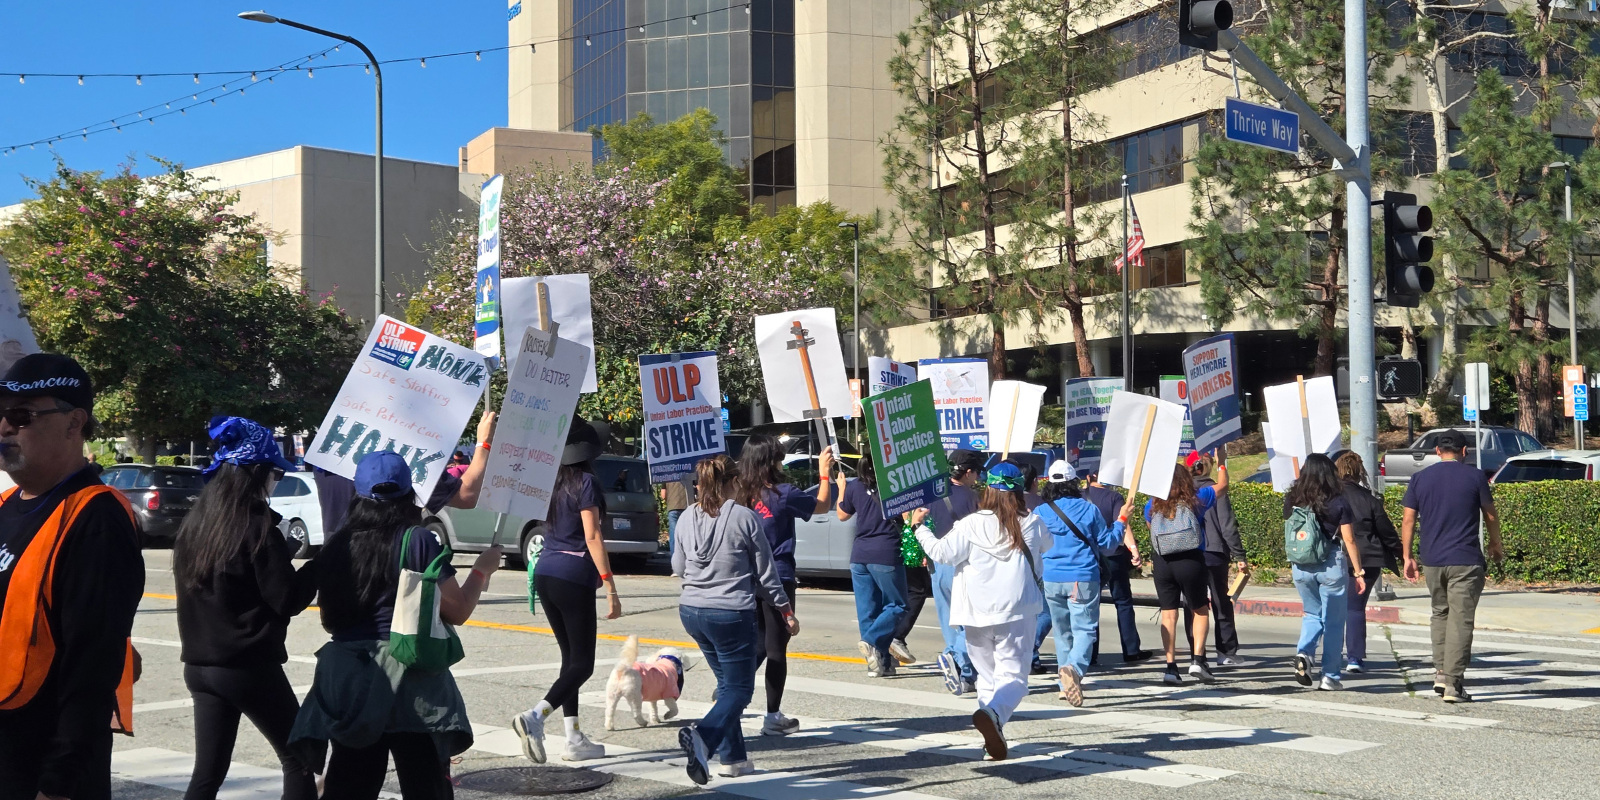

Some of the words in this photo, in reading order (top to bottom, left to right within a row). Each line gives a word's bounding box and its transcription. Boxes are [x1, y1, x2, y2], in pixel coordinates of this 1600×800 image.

[1232, 109, 1267, 137] Thrive
[1271, 118, 1293, 147] Way
[383, 322, 406, 339] ULP
[378, 334, 417, 354] STRIKE
[524, 359, 539, 379] DO
[1189, 356, 1227, 381] HEALTHCARE
[1192, 347, 1218, 367] SUPPORT
[0, 376, 81, 392] Cancun
[359, 360, 396, 385] Safe
[401, 377, 450, 407] Staffing
[652, 363, 702, 406] ULP
[880, 370, 908, 387] STRIKE
[1190, 371, 1232, 405] WORKERS
[650, 411, 665, 422] Unfair
[667, 409, 684, 419] Labor
[686, 404, 713, 416] Practice
[875, 392, 913, 422] Unfair
[942, 397, 958, 405] Labor
[959, 396, 983, 405] Practice
[1076, 406, 1088, 418] RISE
[340, 395, 371, 414] Safe
[375, 406, 418, 431] Patient
[417, 426, 443, 441] Care
[880, 414, 917, 443] Labor
[935, 407, 985, 431] TRIKE
[317, 414, 446, 486] HOK
[499, 442, 528, 458] RESPECT
[648, 417, 720, 459] STRIKE
[883, 430, 935, 463] Practice
[887, 453, 939, 493] STRIKE
